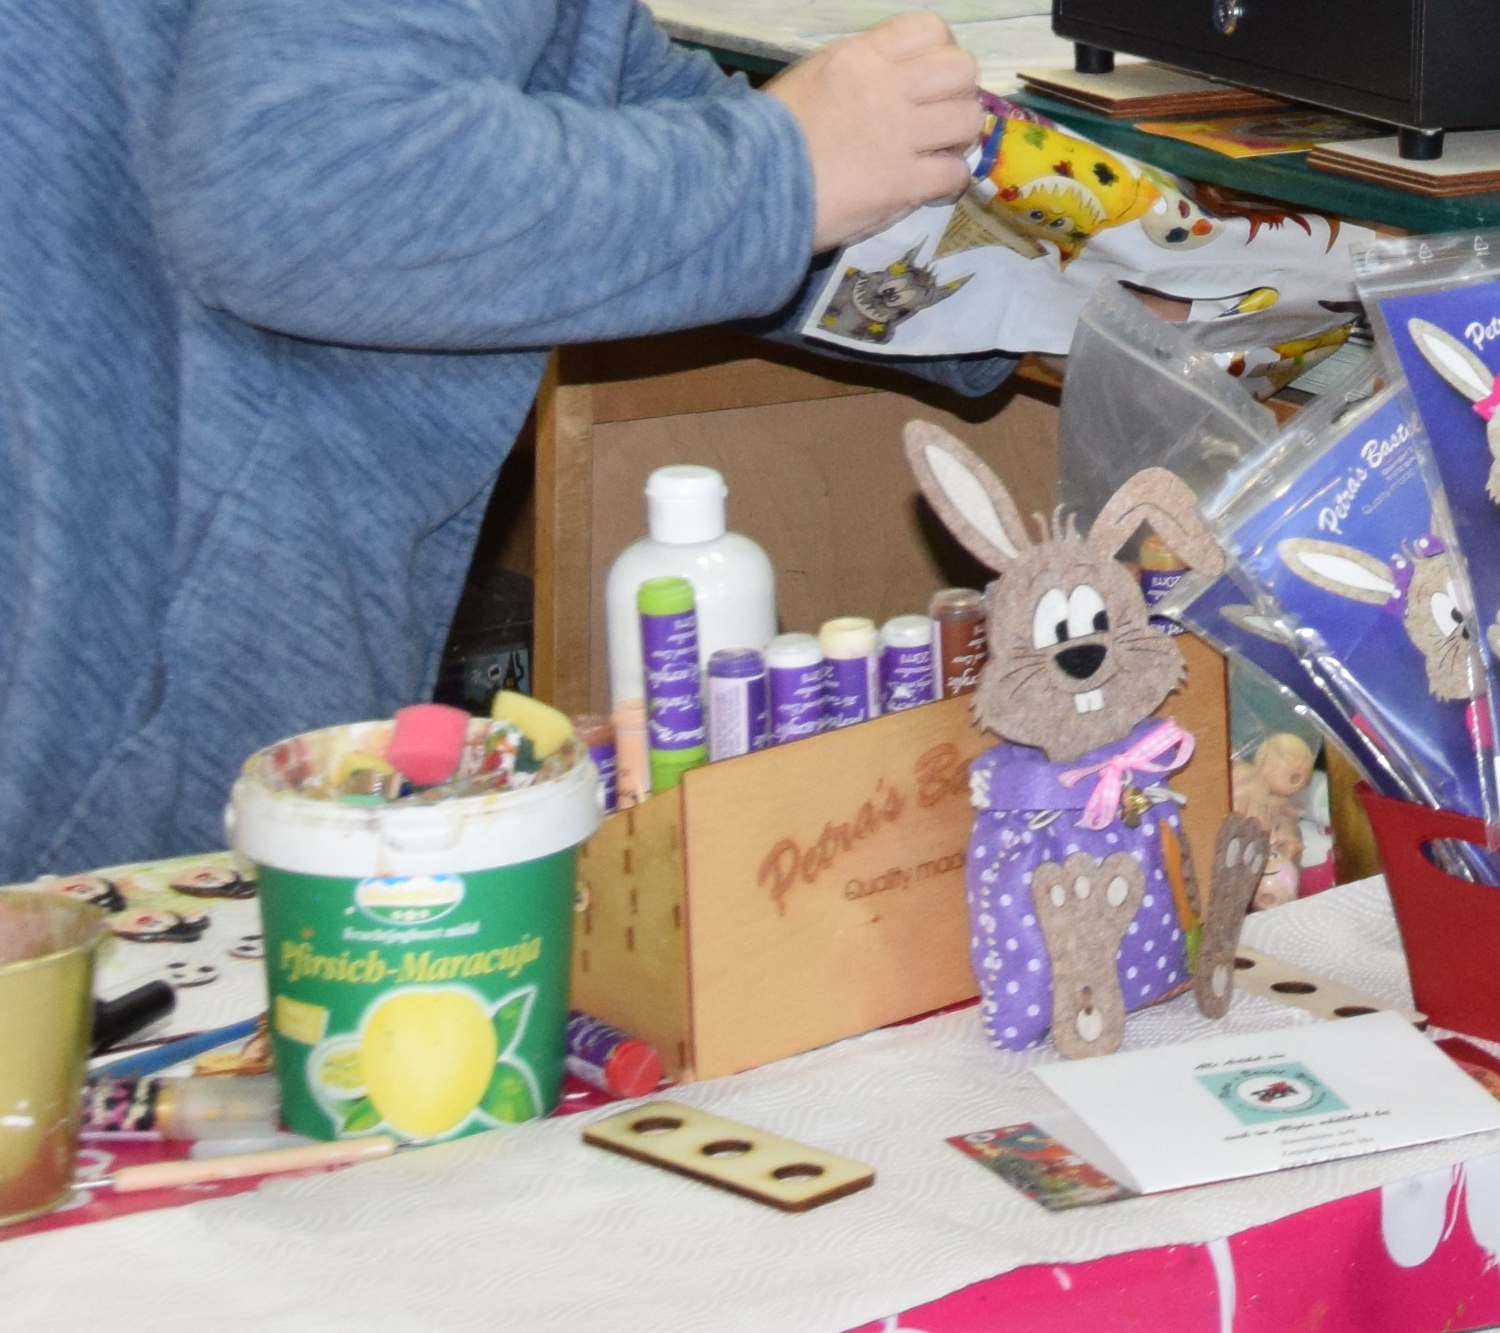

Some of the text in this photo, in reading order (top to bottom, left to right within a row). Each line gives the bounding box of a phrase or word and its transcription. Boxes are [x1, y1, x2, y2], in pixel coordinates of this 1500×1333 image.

[1318, 466, 1369, 536] Petra's
[757, 777, 906, 917] Petra's
[845, 867, 910, 901] Quality
[280, 933, 543, 983] Pfirsich-Maracuja
